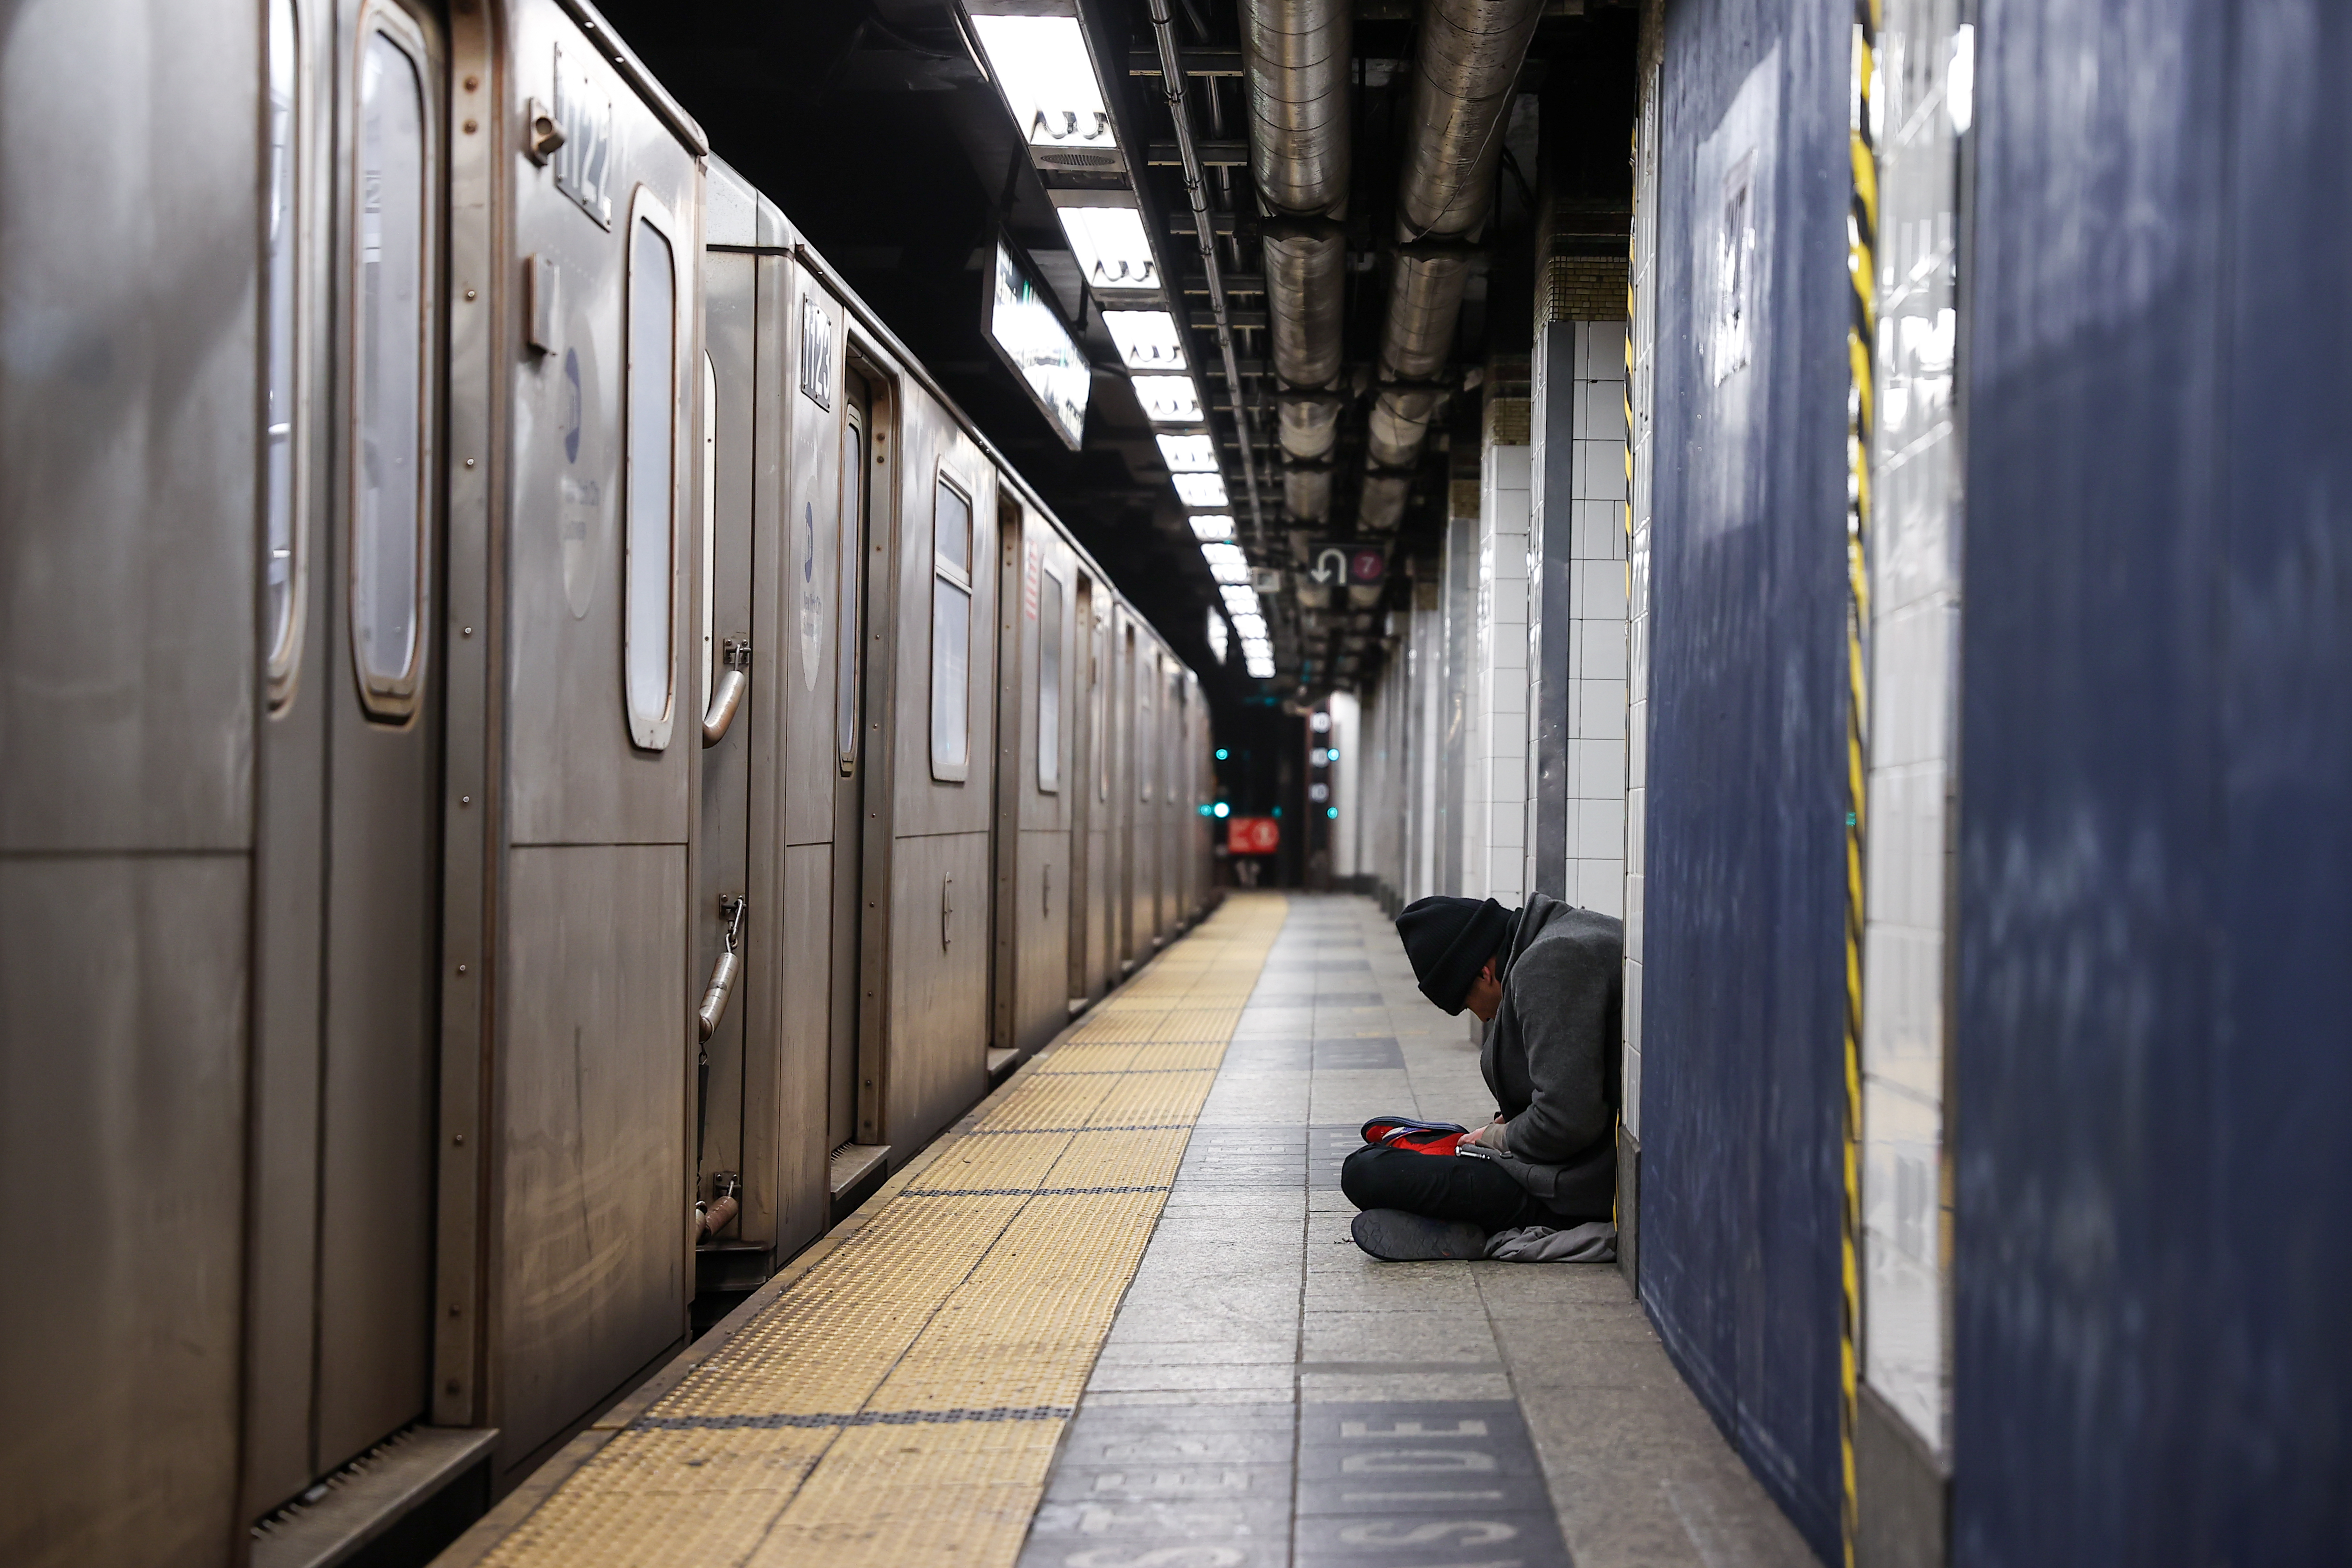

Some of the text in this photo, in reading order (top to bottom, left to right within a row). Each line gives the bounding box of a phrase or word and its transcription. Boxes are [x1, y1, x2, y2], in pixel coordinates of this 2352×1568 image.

[804, 304, 831, 401] 1123
[1361, 556, 1374, 574] 7
[1340, 1420, 1523, 1568] SIDE
